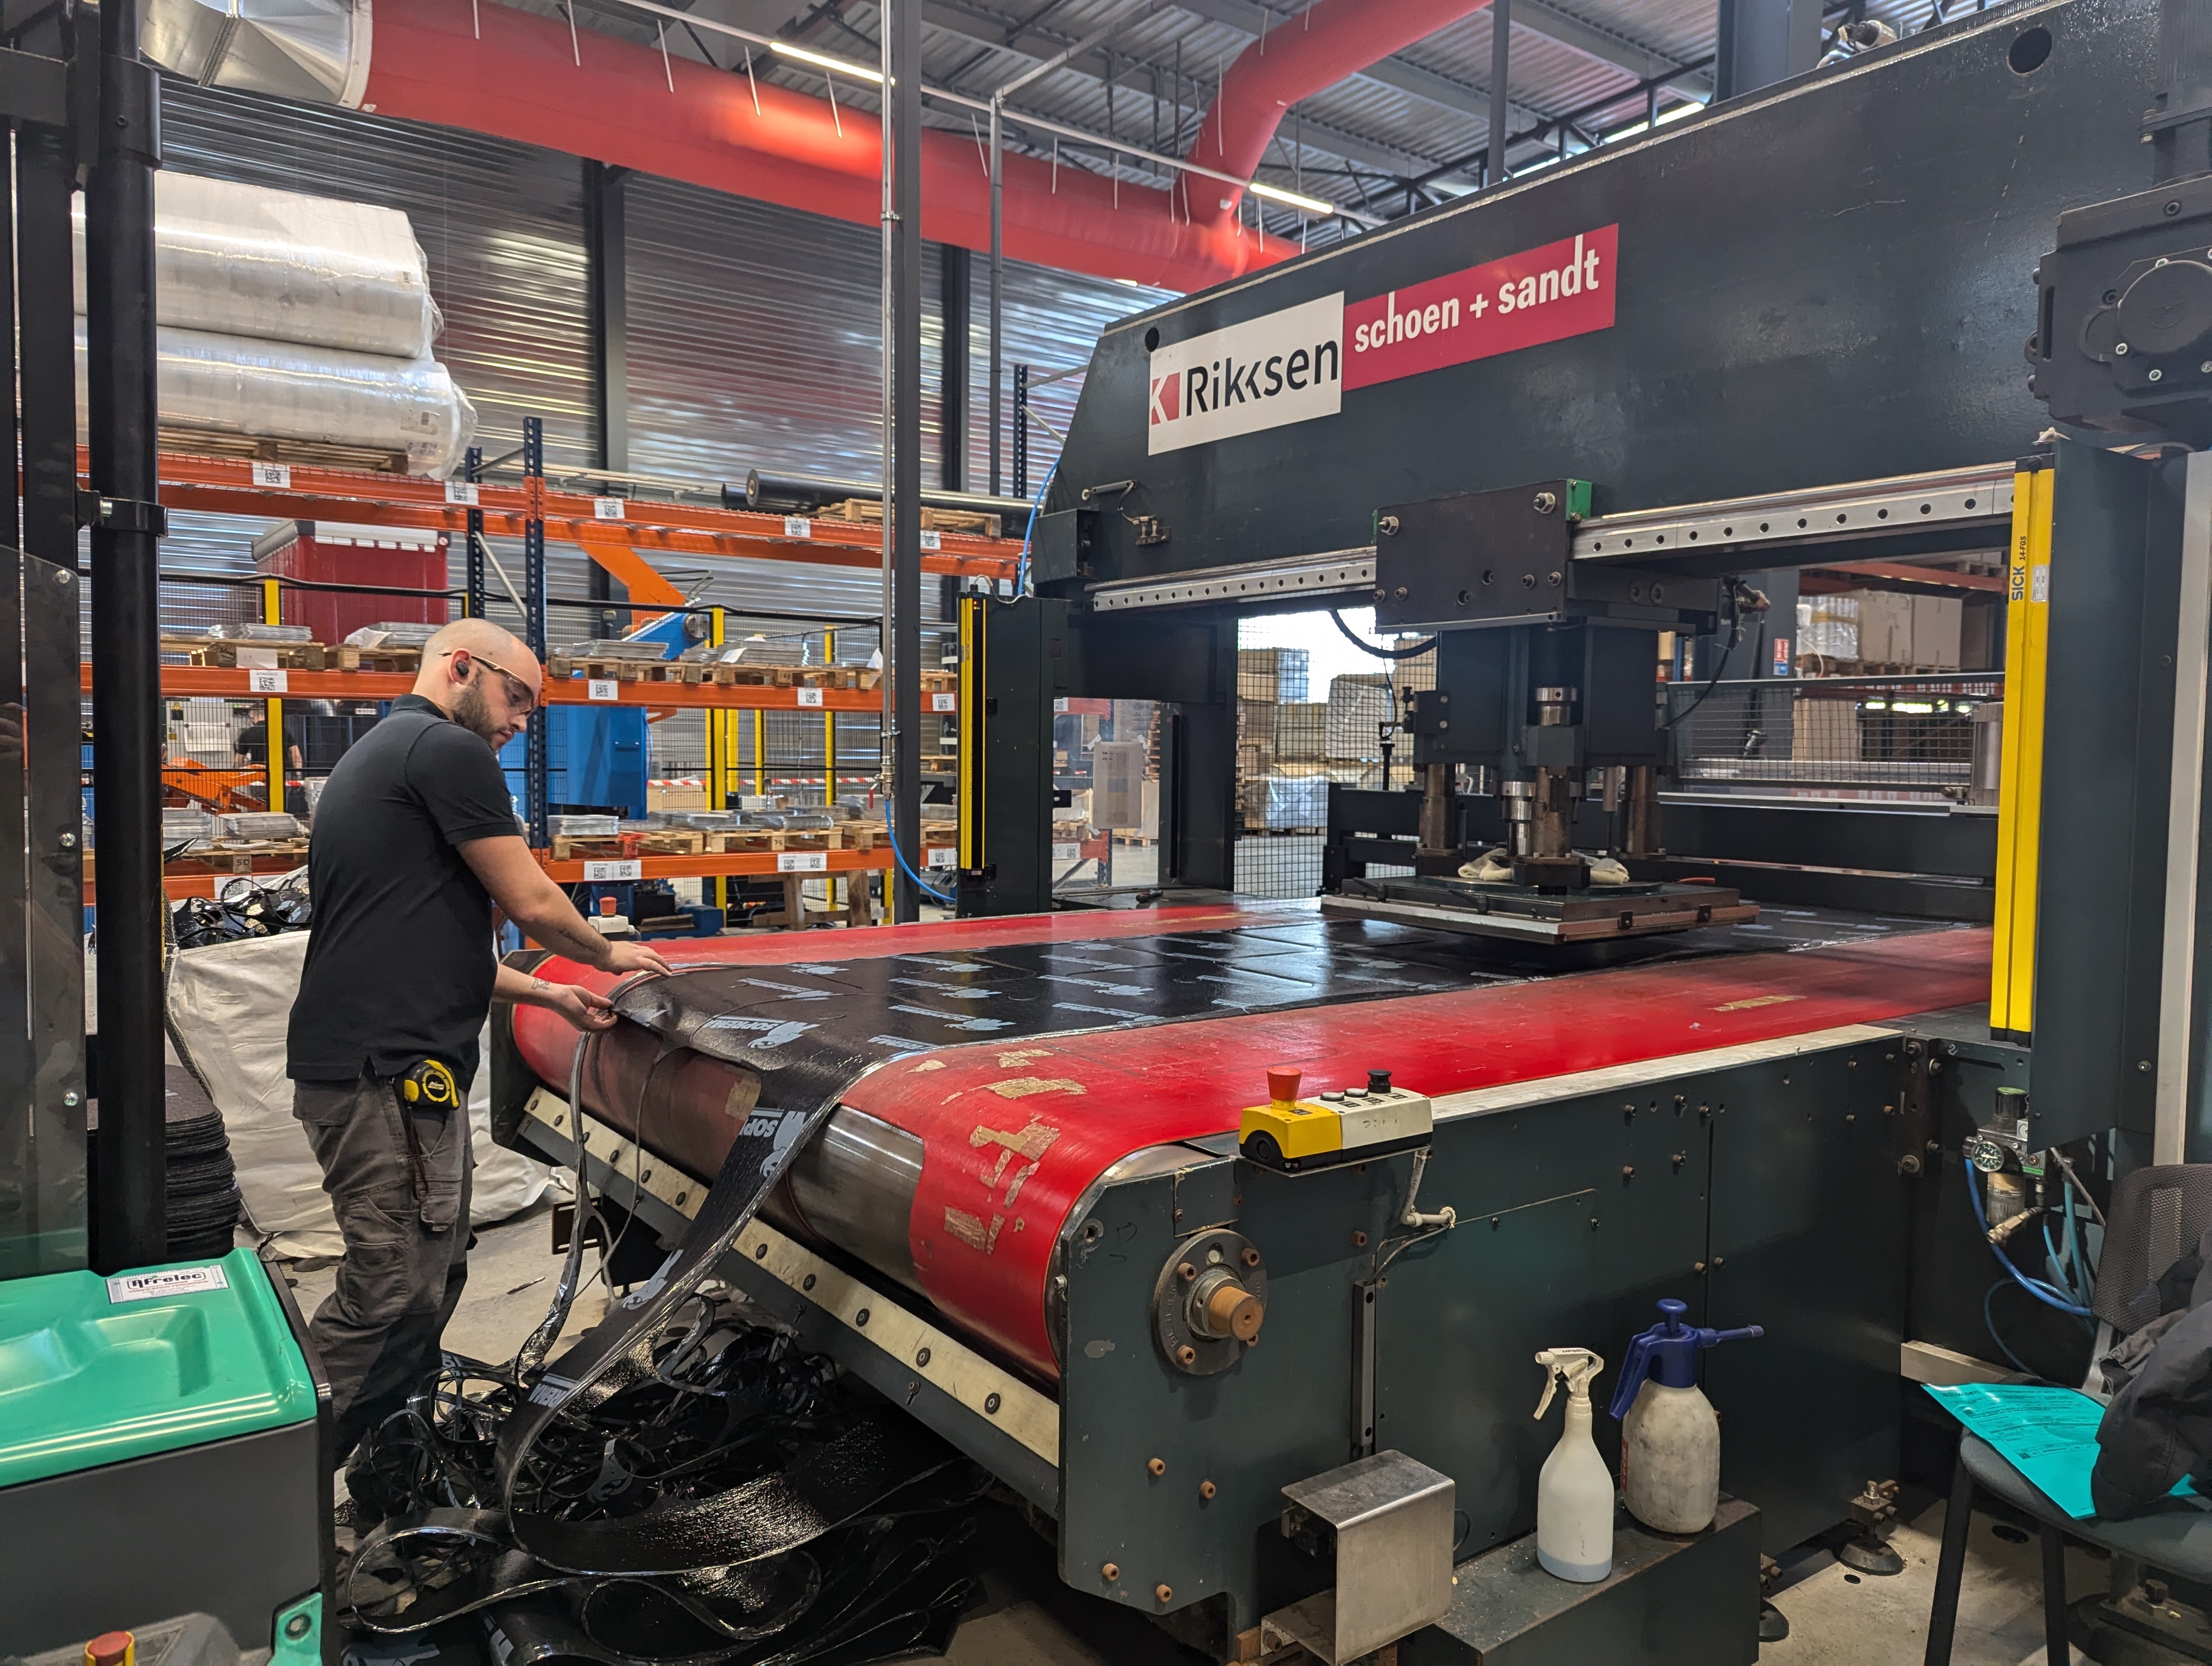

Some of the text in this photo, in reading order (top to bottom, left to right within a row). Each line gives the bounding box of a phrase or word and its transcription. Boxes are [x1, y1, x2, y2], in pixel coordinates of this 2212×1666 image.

[1354, 234, 1600, 353] schoen + sandt
[2011, 565, 2025, 601] SICK
